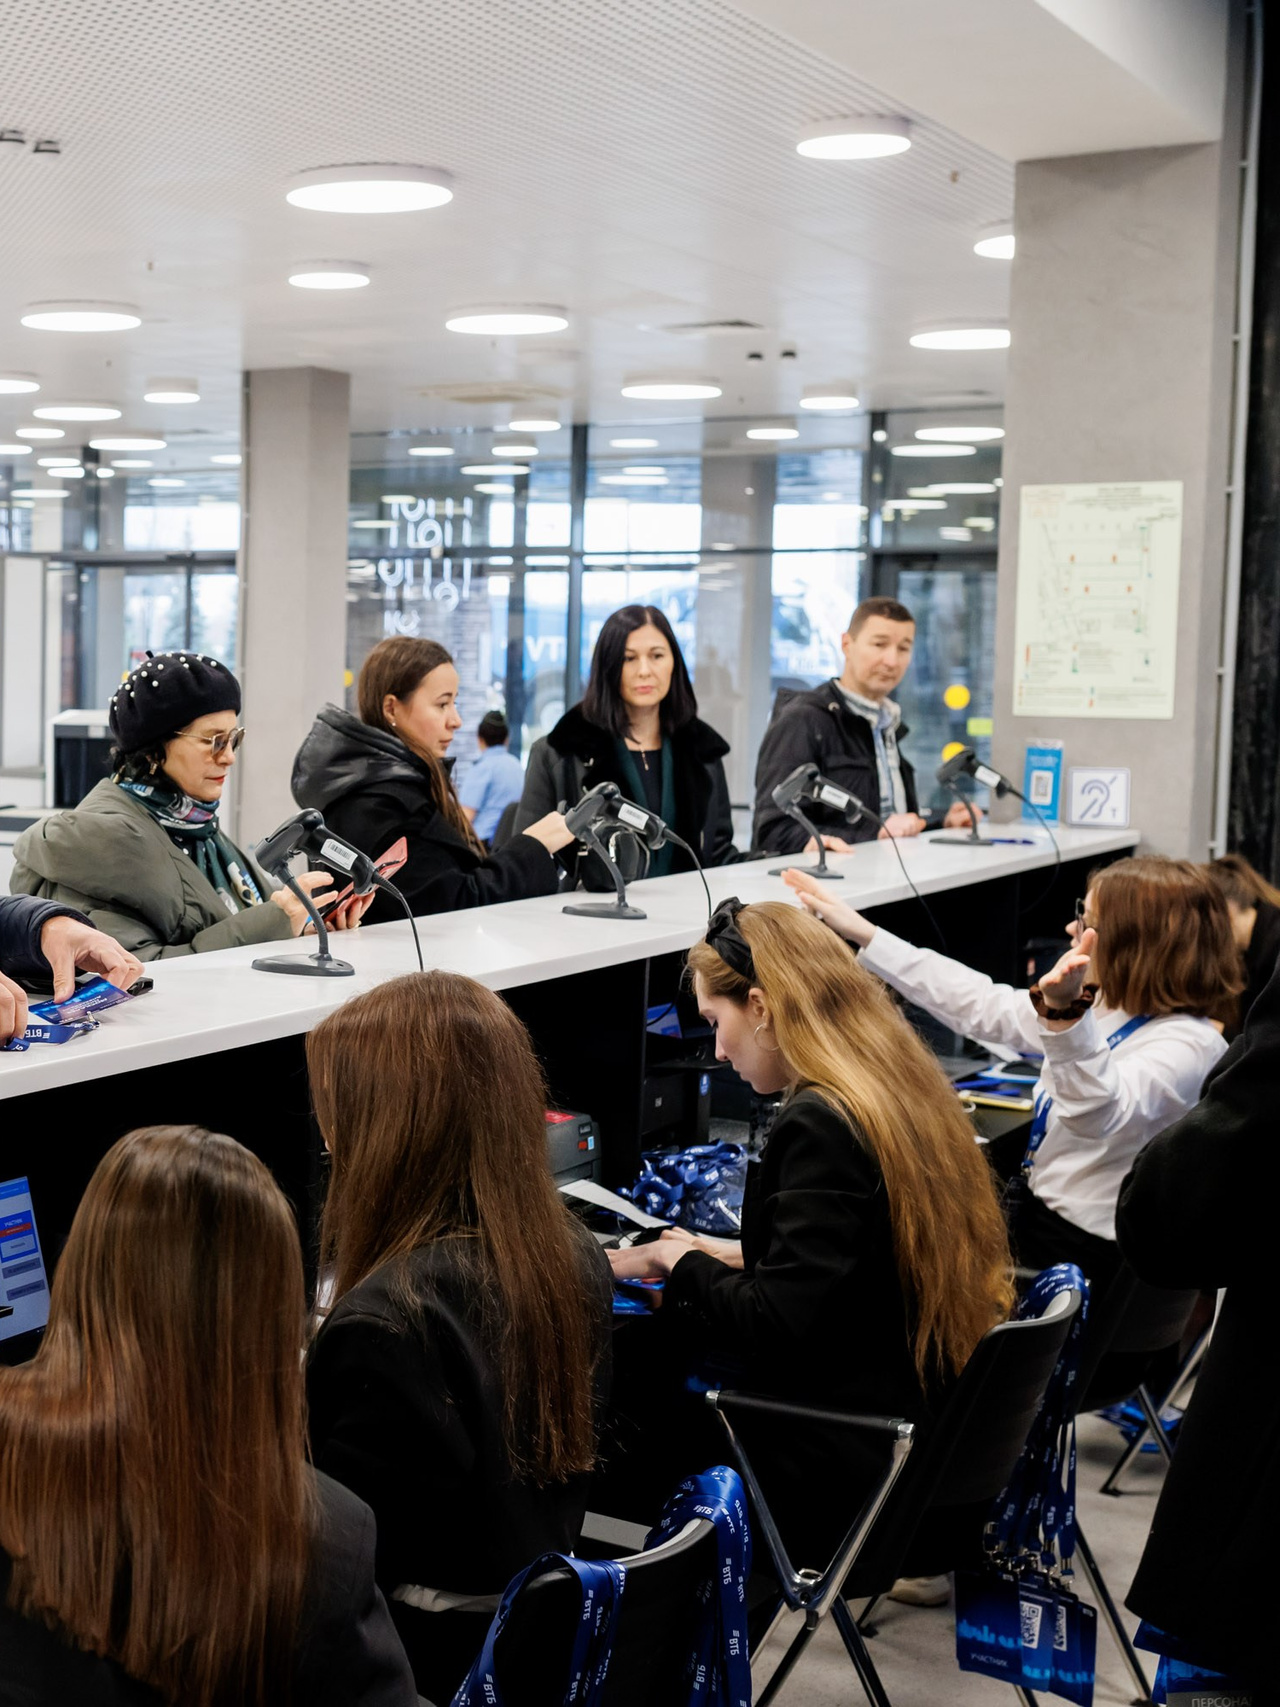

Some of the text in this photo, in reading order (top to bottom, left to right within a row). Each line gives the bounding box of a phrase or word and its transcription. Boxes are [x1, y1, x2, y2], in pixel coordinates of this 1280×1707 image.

[722, 1565, 732, 1585] ВТБ
[583, 1600, 592, 1621] ВТБ
[729, 1637, 740, 1656] ВТБ
[970, 1652, 1009, 1667] УЧАСТНИК
[696, 1664, 707, 1683] ВТБ
[483, 1683, 497, 1705] ВТБ
[570, 1681, 579, 1702] ВТБ
